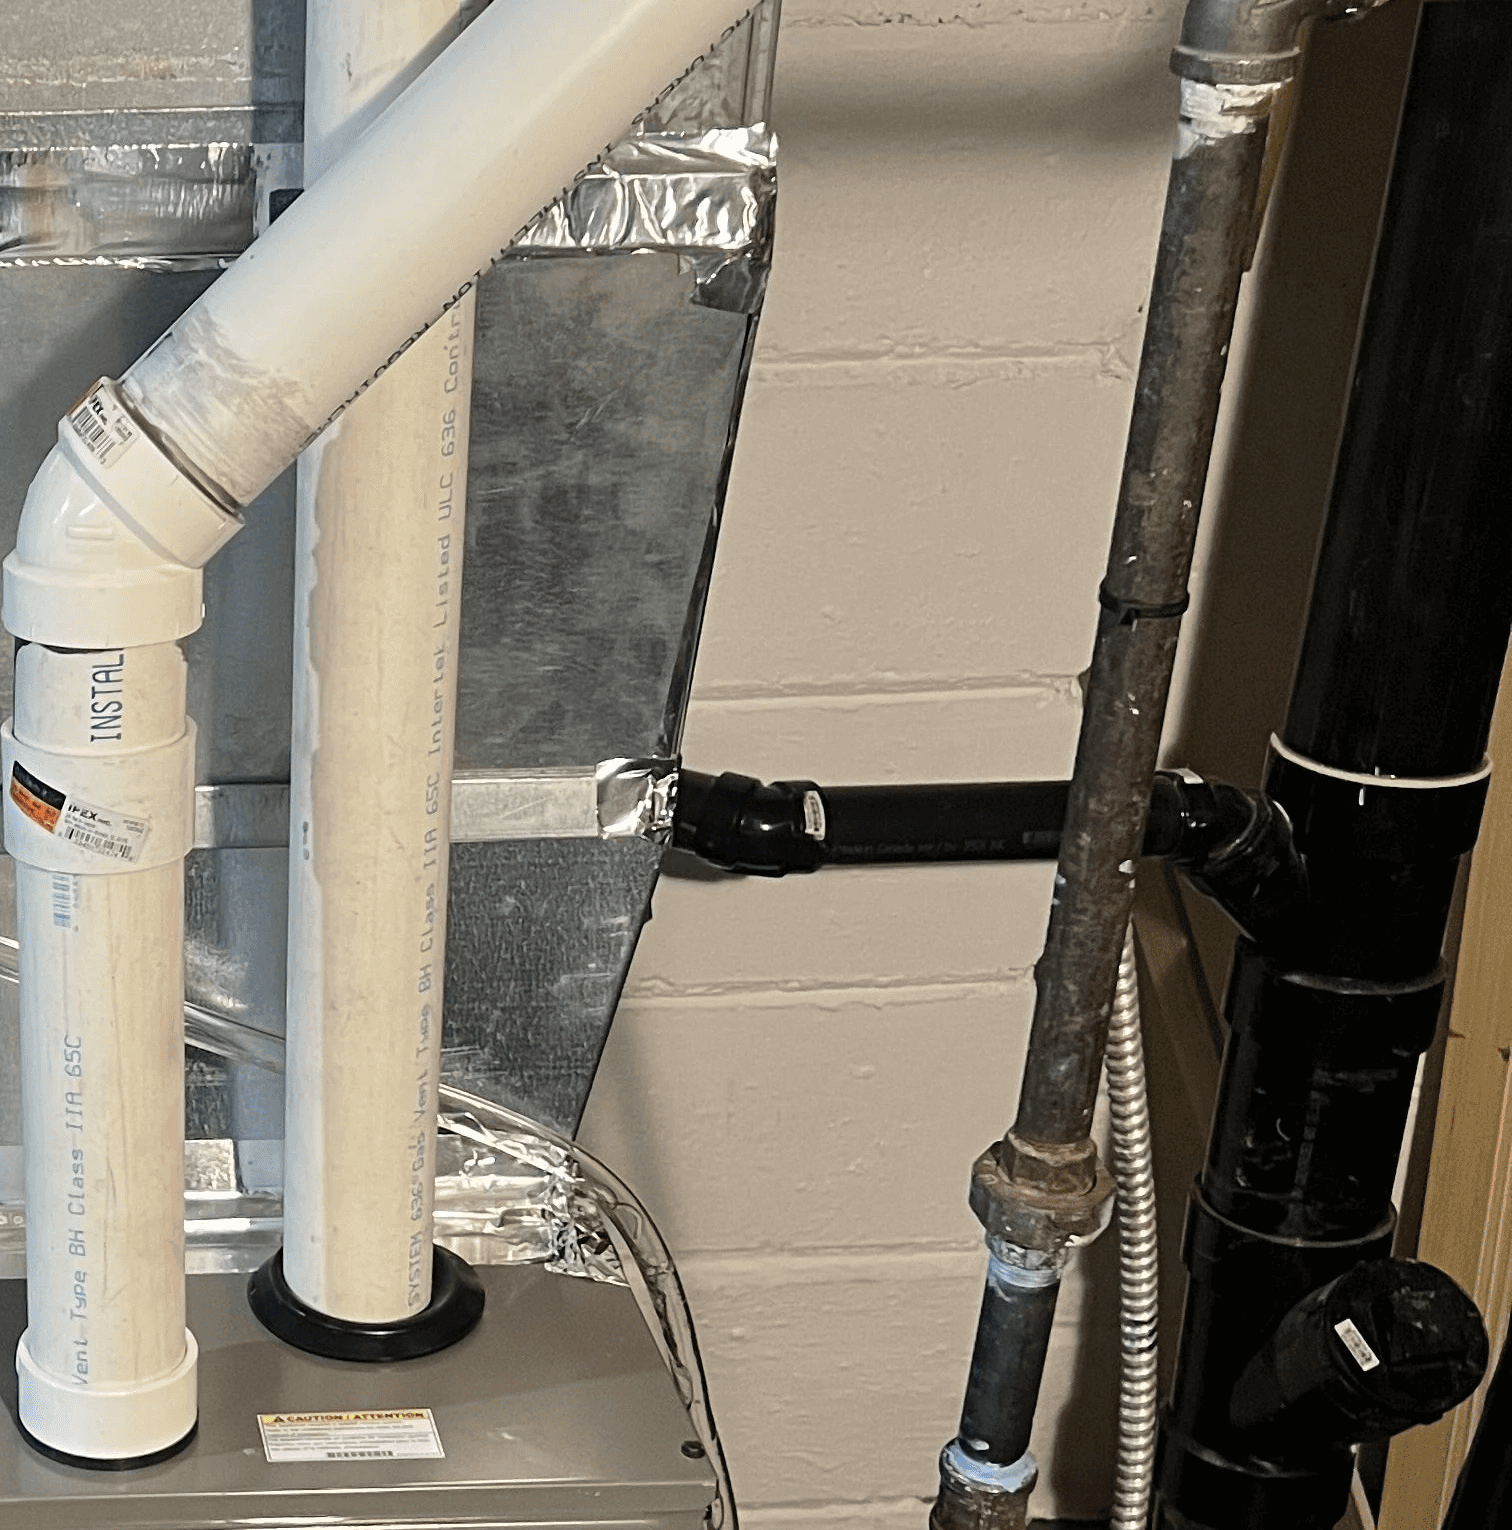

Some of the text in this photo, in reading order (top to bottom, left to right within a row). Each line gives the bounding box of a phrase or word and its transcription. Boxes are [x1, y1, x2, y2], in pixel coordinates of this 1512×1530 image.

[441, 409, 456, 457] 636
[64, 1034, 84, 1077] 65C
[65, 1091, 85, 1133] IIA
[66, 1148, 86, 1214] Class
[68, 1228, 86, 1258] BH
[70, 1269, 89, 1326] Type
[287, 1411, 426, 1423] CAUTION ATTENTION
